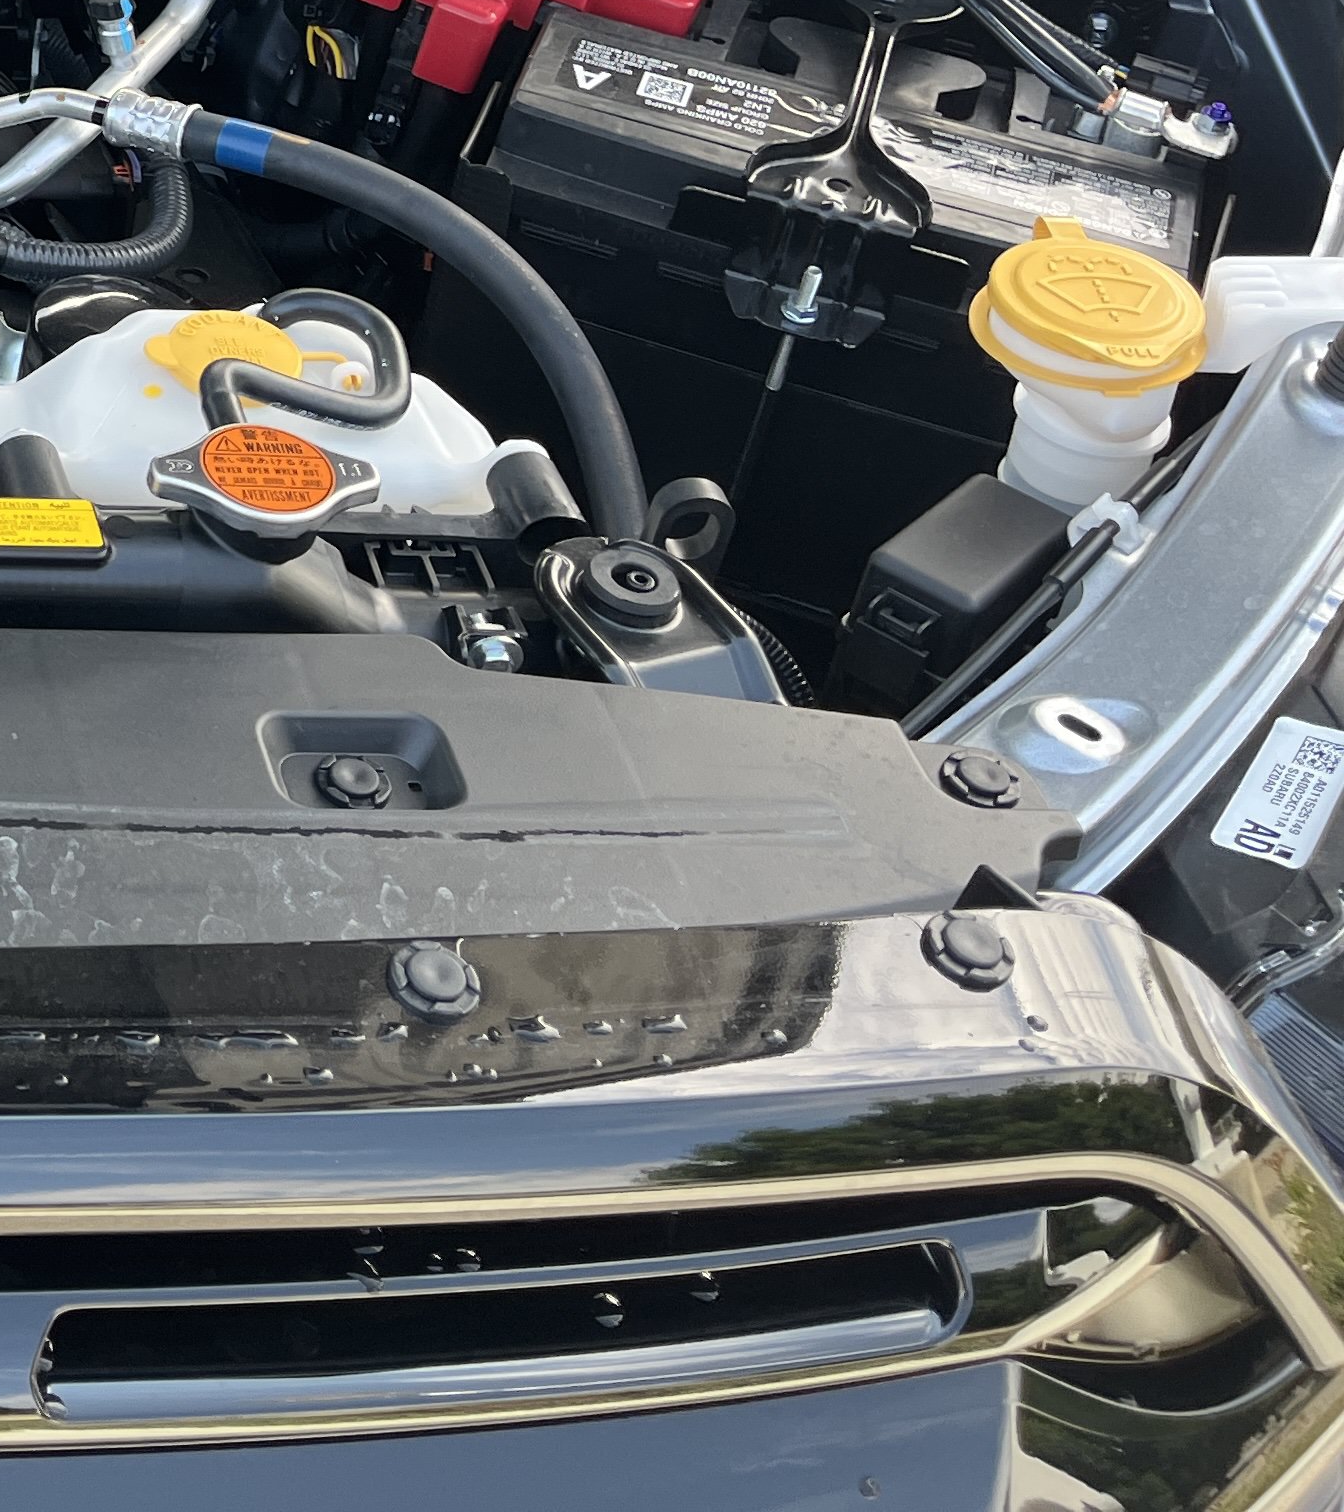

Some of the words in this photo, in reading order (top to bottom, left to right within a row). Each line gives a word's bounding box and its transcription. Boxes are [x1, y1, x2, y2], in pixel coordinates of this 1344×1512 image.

[645, 99, 675, 111] AMPS
[706, 99, 728, 109] SIZE
[743, 100, 771, 113] LN2
[677, 108, 732, 126] CRANKING
[696, 105, 738, 121] AMPS
[731, 106, 769, 120] GROUP
[734, 123, 764, 135] COLD
[242, 441, 303, 455] WARNING
[214, 466, 242, 474] NEVER
[247, 467, 270, 475] OPEN
[274, 468, 299, 476] WHEN
[1270, 767, 1299, 807] SUBARU
[1275, 771, 1315, 828] 84002XC11A
[1233, 818, 1281, 854] AD
